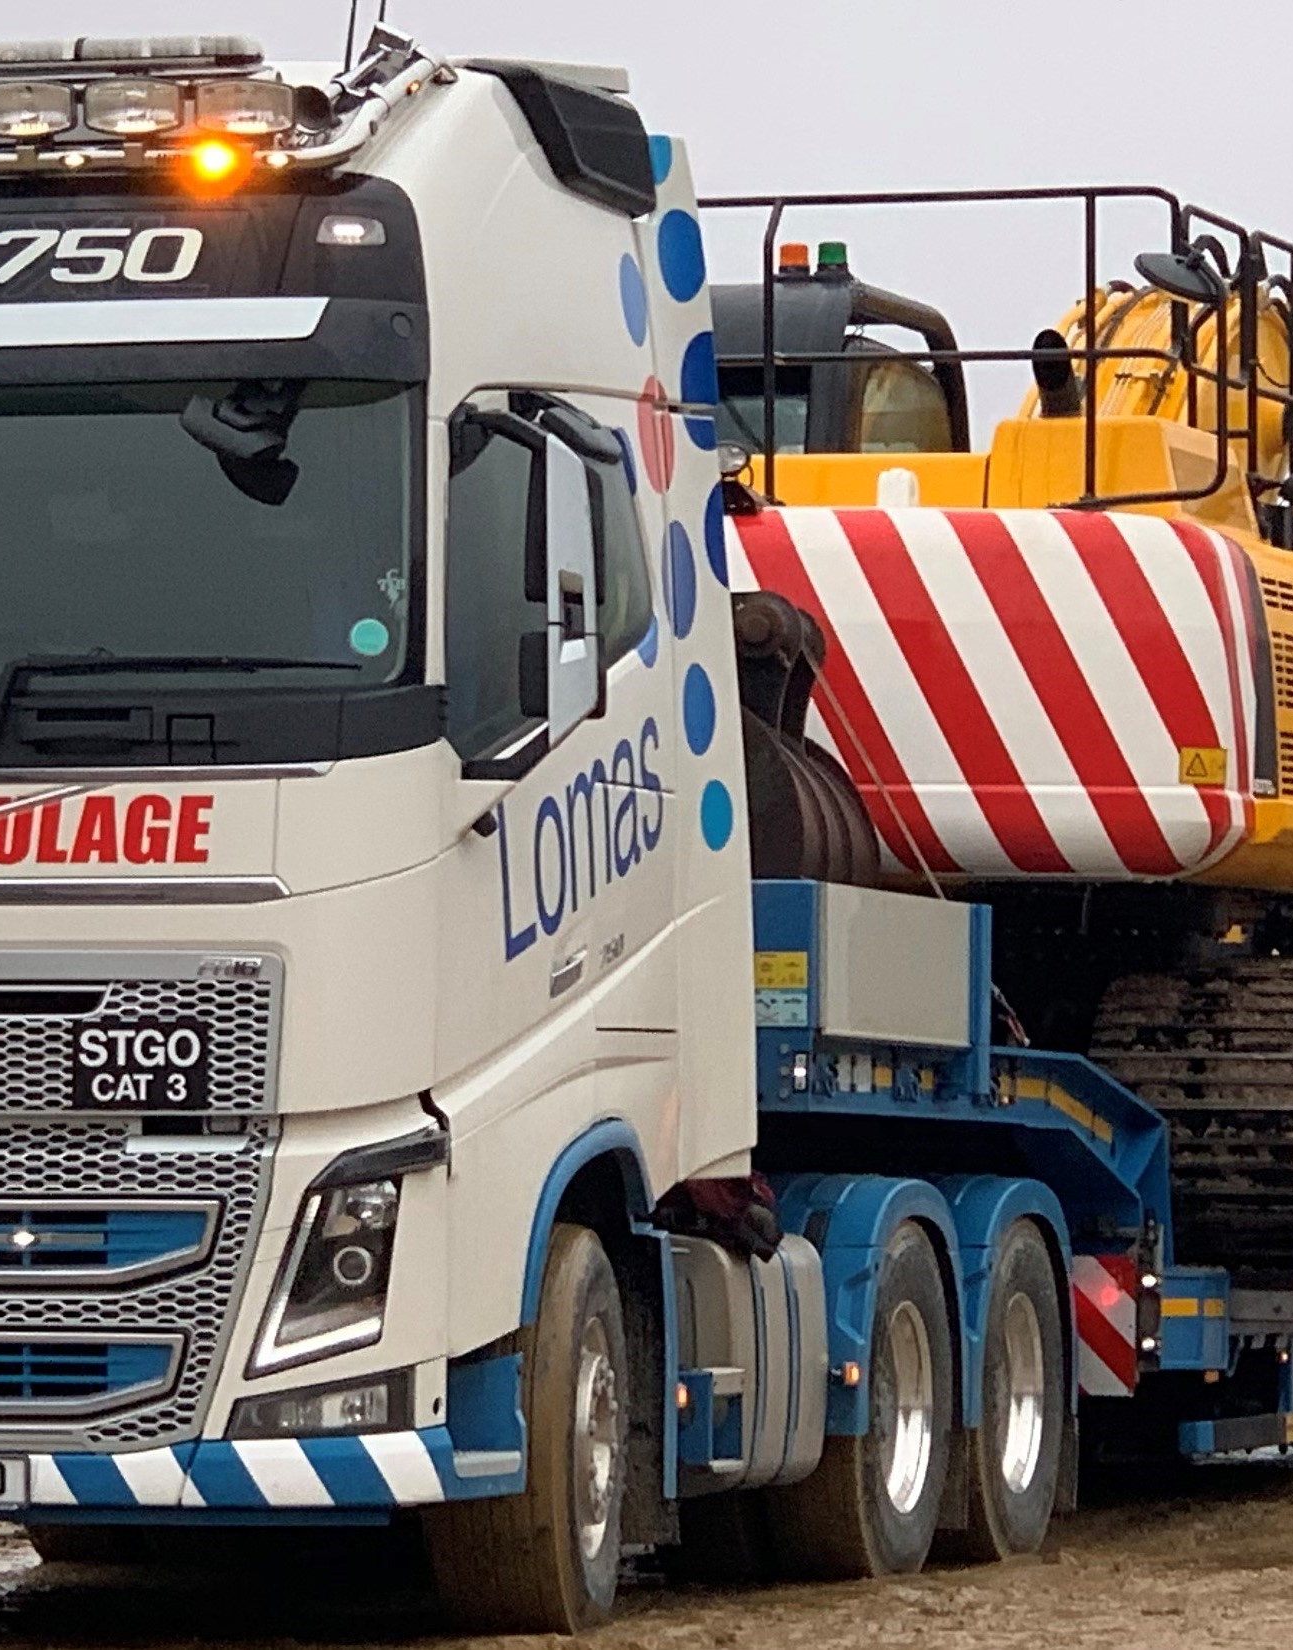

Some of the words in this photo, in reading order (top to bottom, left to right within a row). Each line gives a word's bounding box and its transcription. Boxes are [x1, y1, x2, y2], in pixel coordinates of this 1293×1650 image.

[497, 716, 664, 963] Lomas
[78, 1028, 202, 1068] STGO
[91, 1073, 154, 1102] CAT
[166, 1073, 188, 1102] 3
